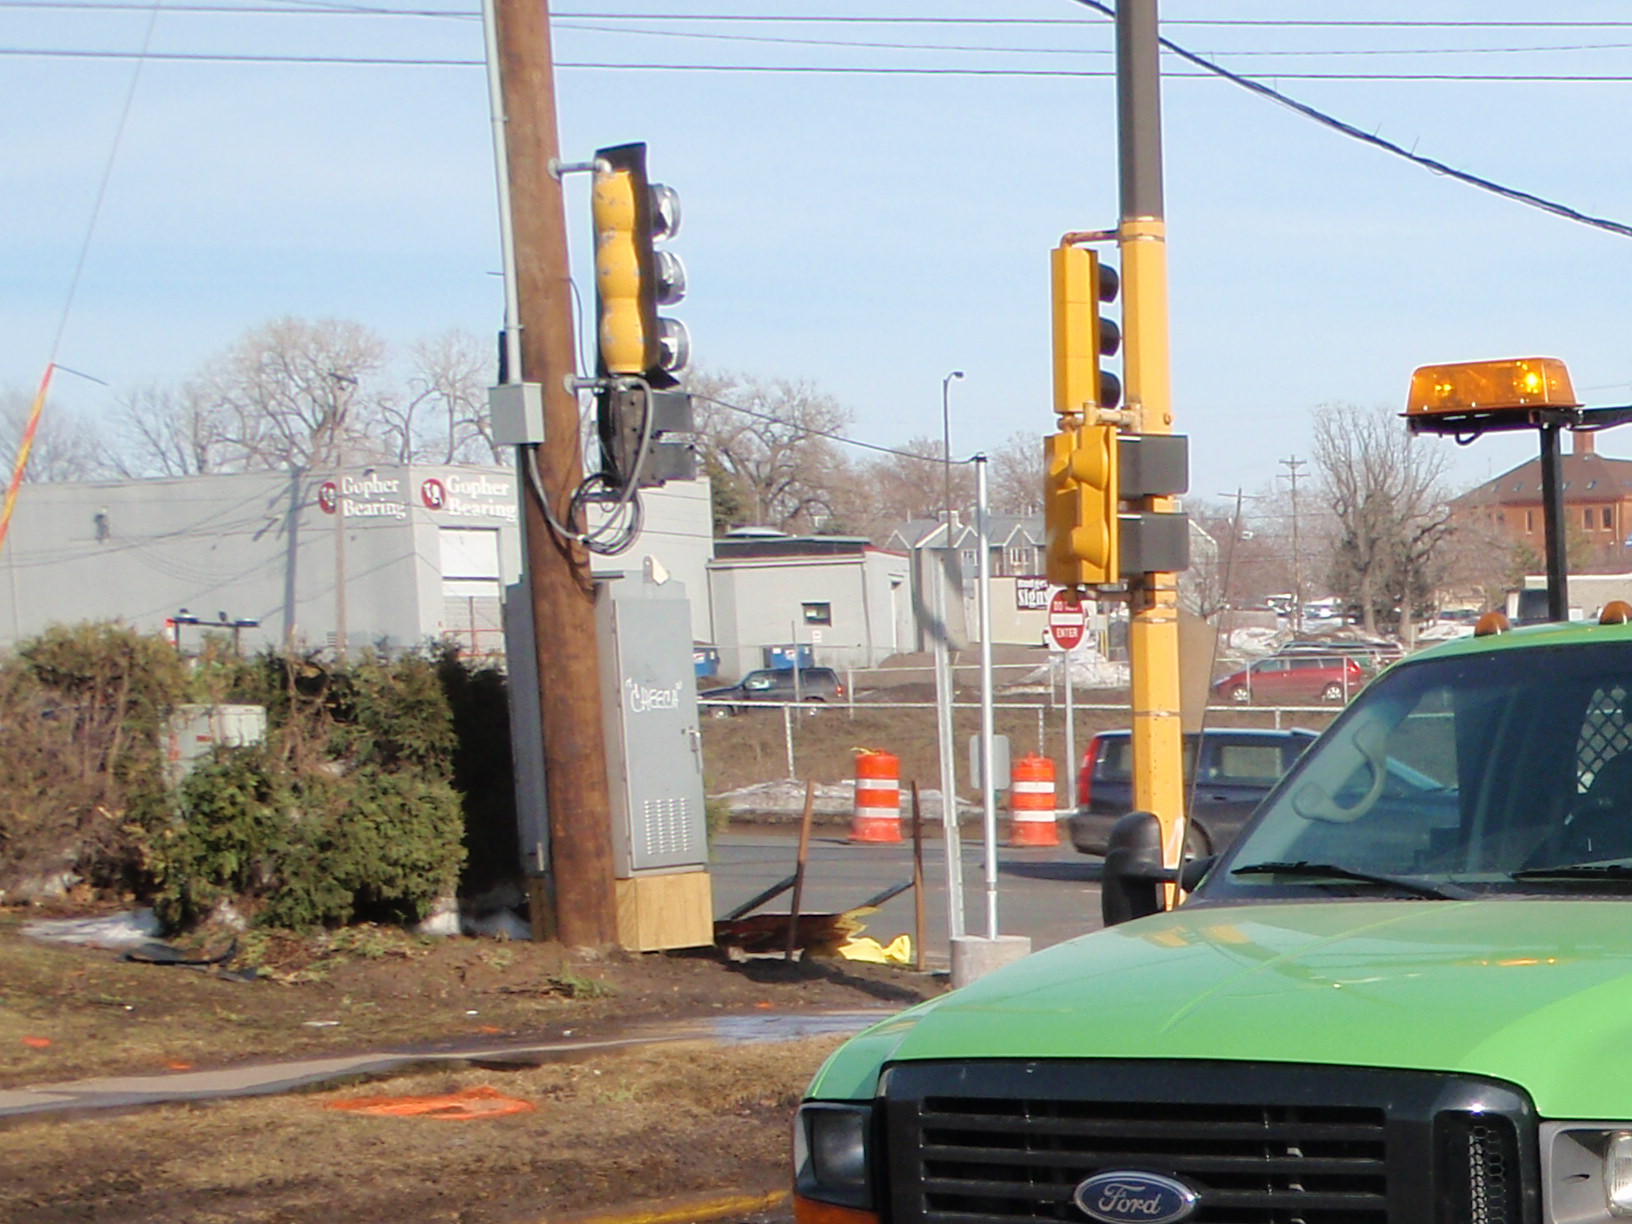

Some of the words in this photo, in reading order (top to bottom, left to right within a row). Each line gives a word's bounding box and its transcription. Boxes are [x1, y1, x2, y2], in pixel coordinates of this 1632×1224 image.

[342, 474, 400, 498] Gopher
[446, 475, 510, 499] Gopher
[343, 499, 406, 520] Bearing
[449, 499, 517, 522] Bearing
[1053, 601, 1063, 611] DO
[1056, 628, 1078, 638] ENTER
[1098, 1182, 1161, 1215] Ford
